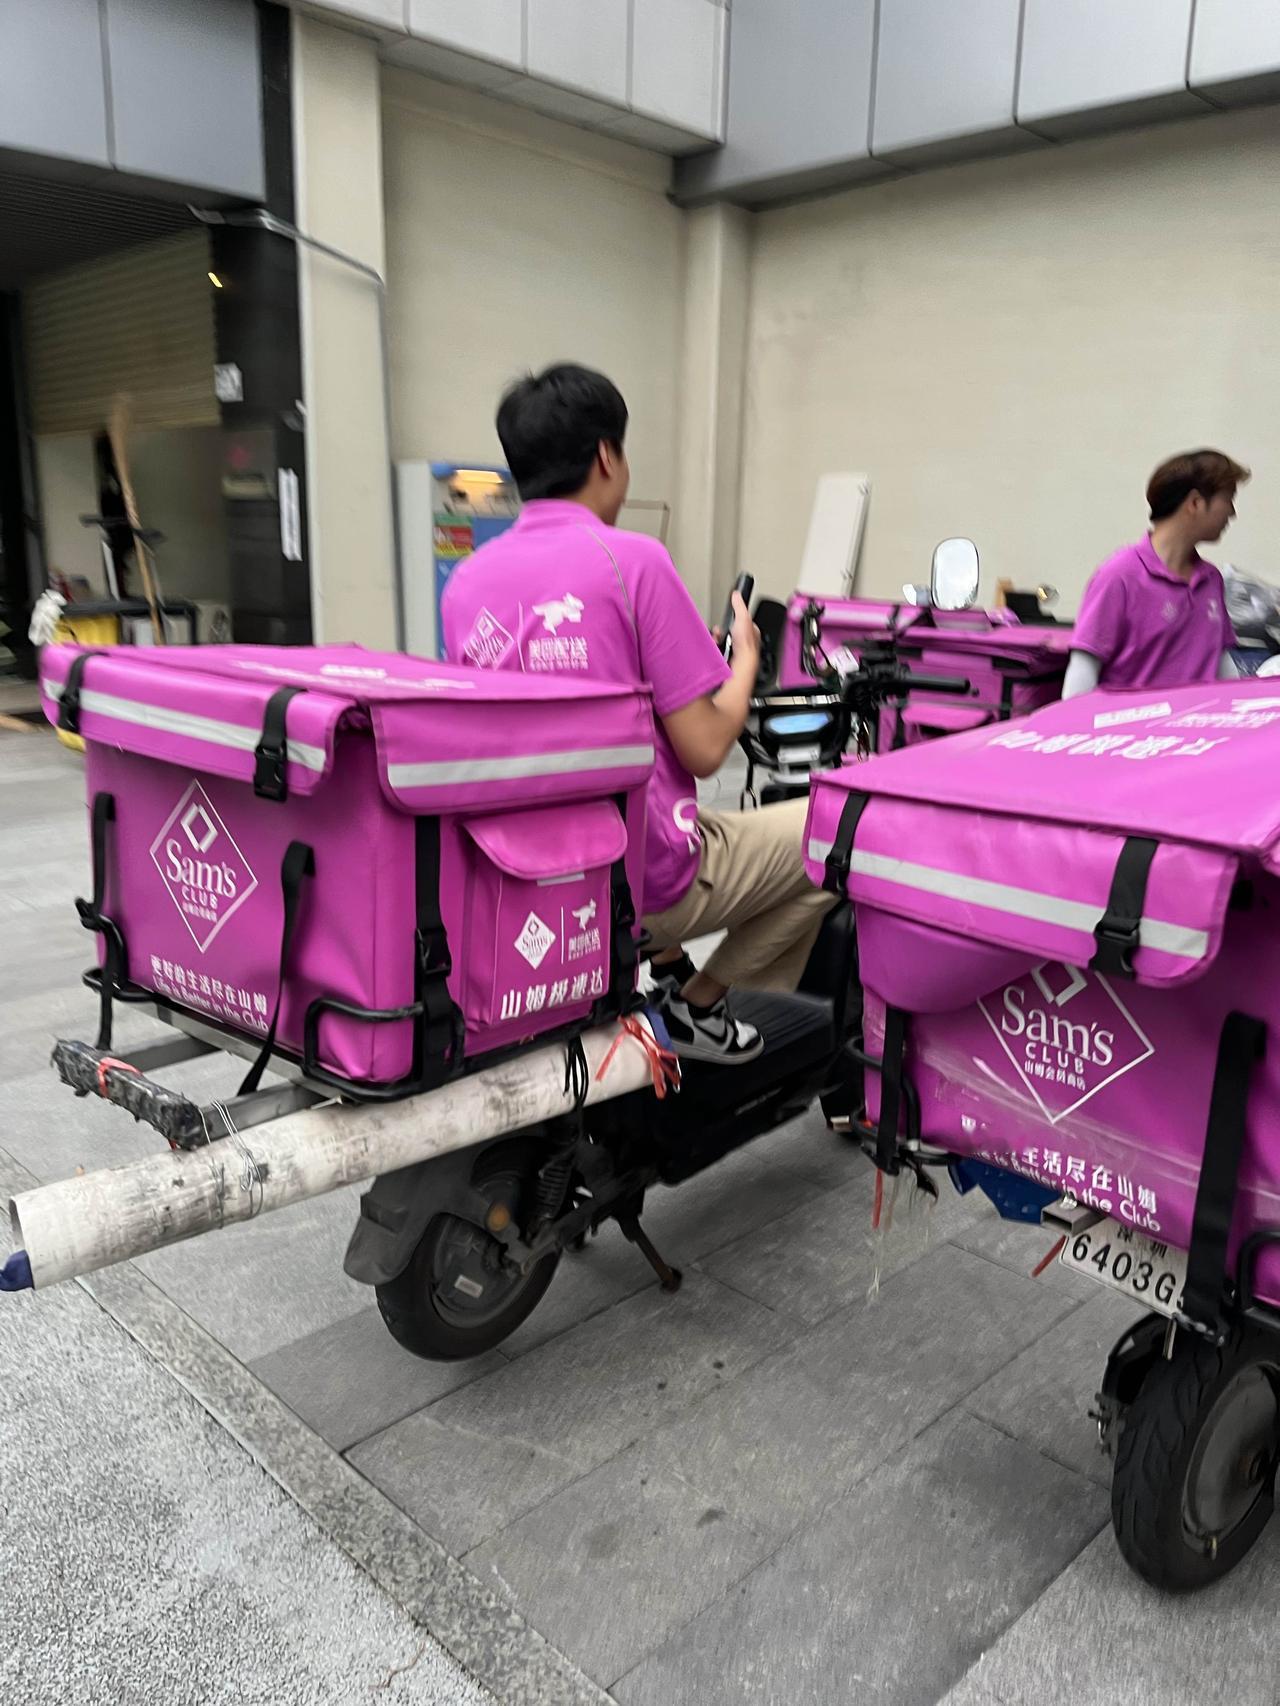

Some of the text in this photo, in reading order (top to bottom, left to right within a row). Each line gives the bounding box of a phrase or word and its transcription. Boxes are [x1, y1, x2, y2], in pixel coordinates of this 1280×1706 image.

[166, 838, 237, 898] Sam's
[181, 885, 219, 909] CLUB
[1002, 985, 1115, 1066] Sam's
[1025, 1042, 1085, 1074] CLUB
[1082, 1186, 1113, 1213] the
[1119, 1200, 1161, 1232] Club
[1072, 1233, 1184, 1309] 6403G
